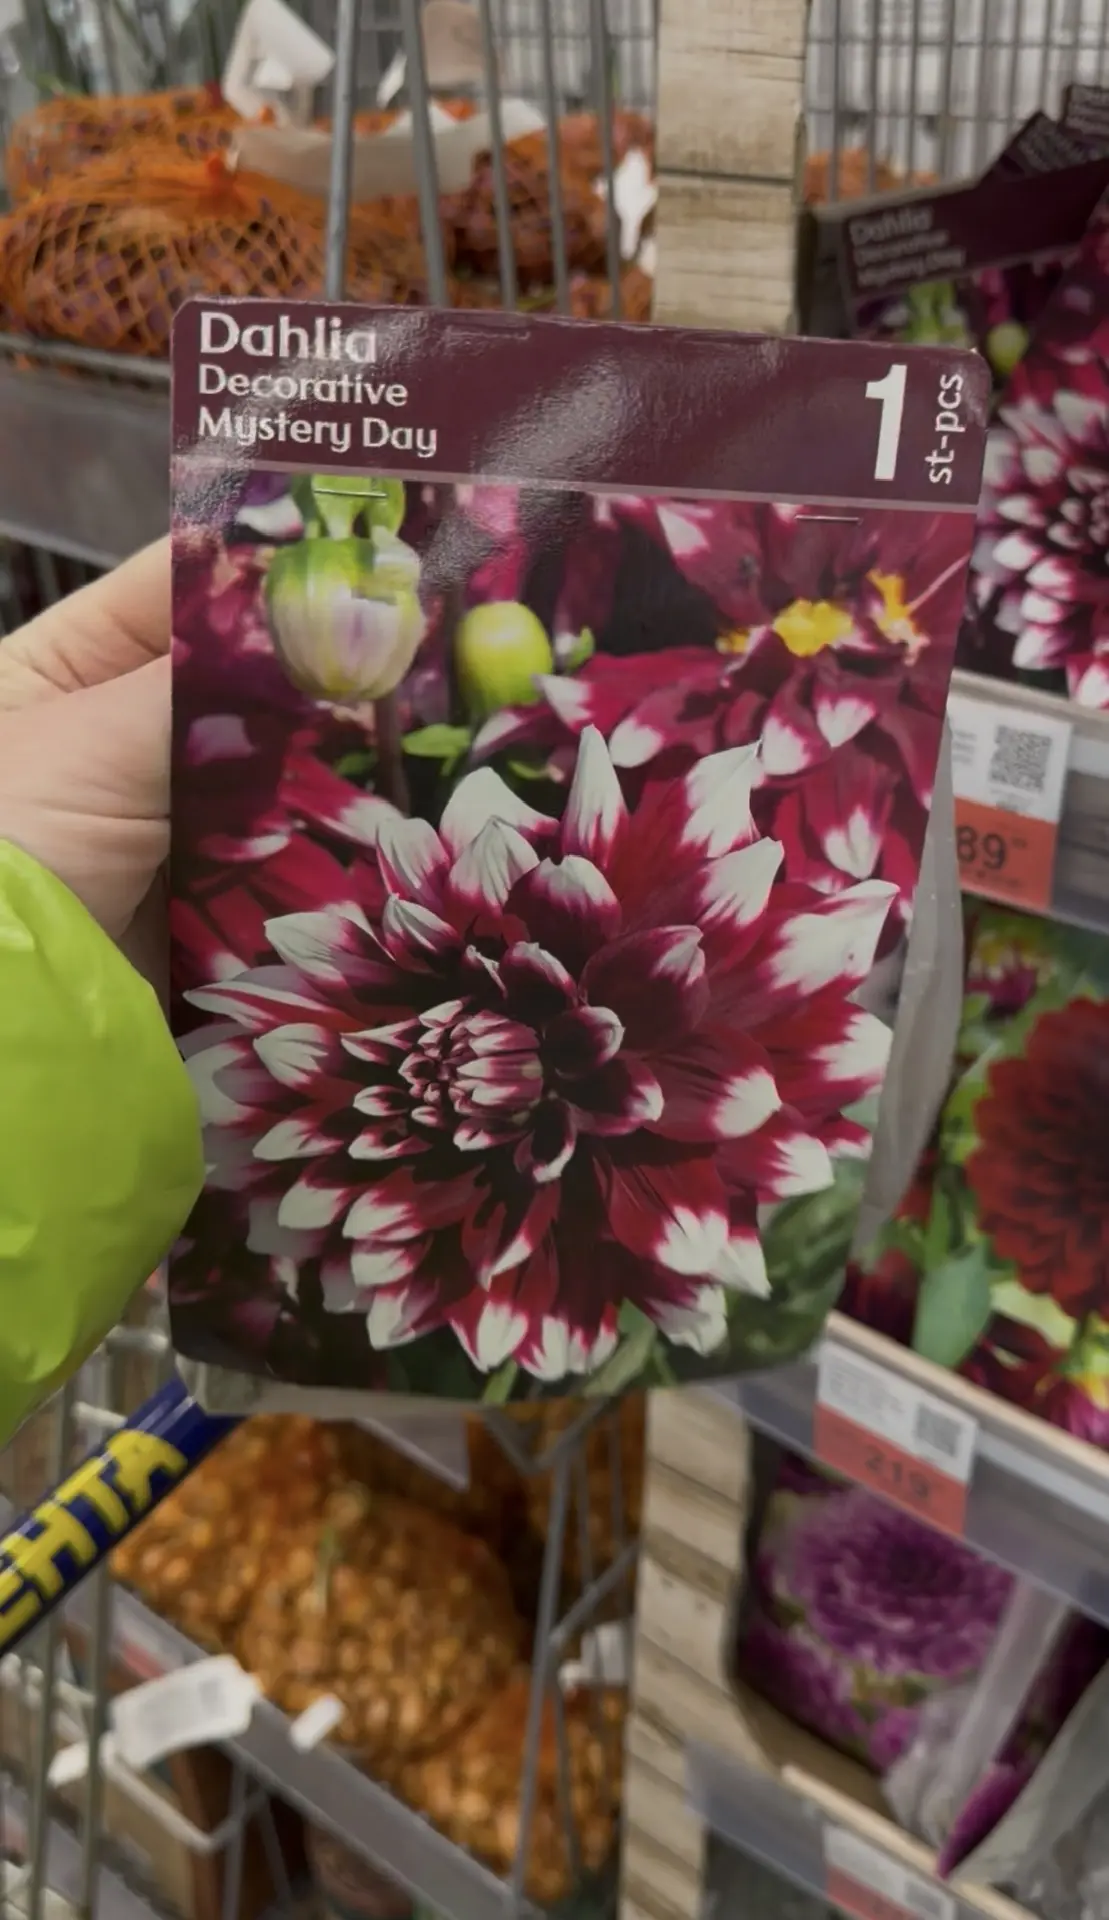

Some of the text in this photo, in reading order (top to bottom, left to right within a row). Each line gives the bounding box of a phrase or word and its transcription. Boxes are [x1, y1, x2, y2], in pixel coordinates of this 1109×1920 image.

[200, 311, 377, 363] Dahlia
[198, 363, 409, 407] Decorative
[198, 406, 438, 458] Mystery Day
[865, 364, 908, 481] 1
[924, 373, 966, 485] st-pcs
